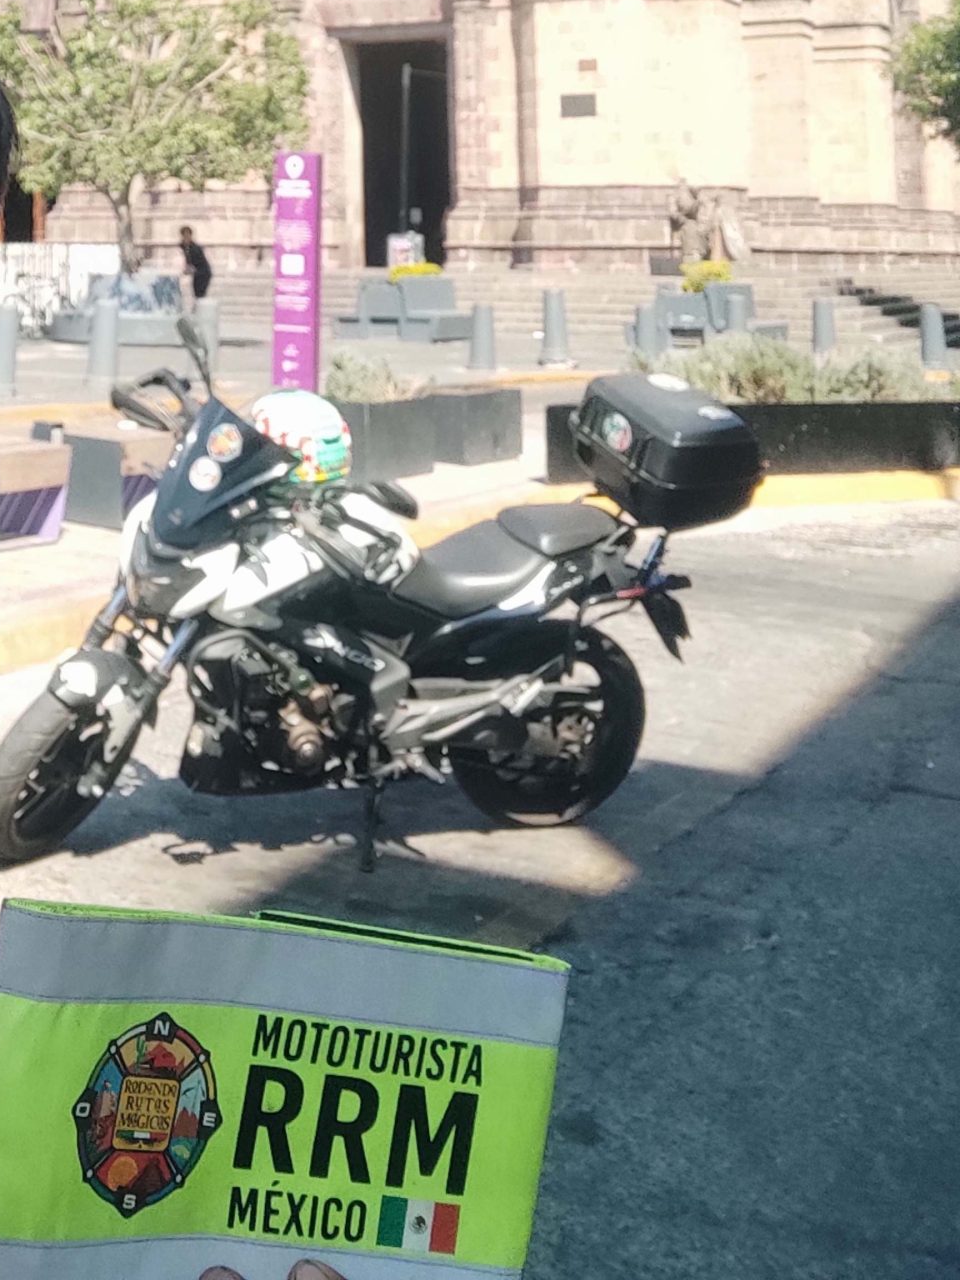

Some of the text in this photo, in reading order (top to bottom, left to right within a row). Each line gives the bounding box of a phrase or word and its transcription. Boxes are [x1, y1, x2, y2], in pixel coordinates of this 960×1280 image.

[154, 1020, 170, 1035] N
[252, 1014, 483, 1087] MOTOTURISTA
[202, 1111, 216, 1128] E
[232, 1064, 479, 1196] RRM
[122, 1194, 136, 1209] S
[227, 1181, 368, 1242] MÉXICO
